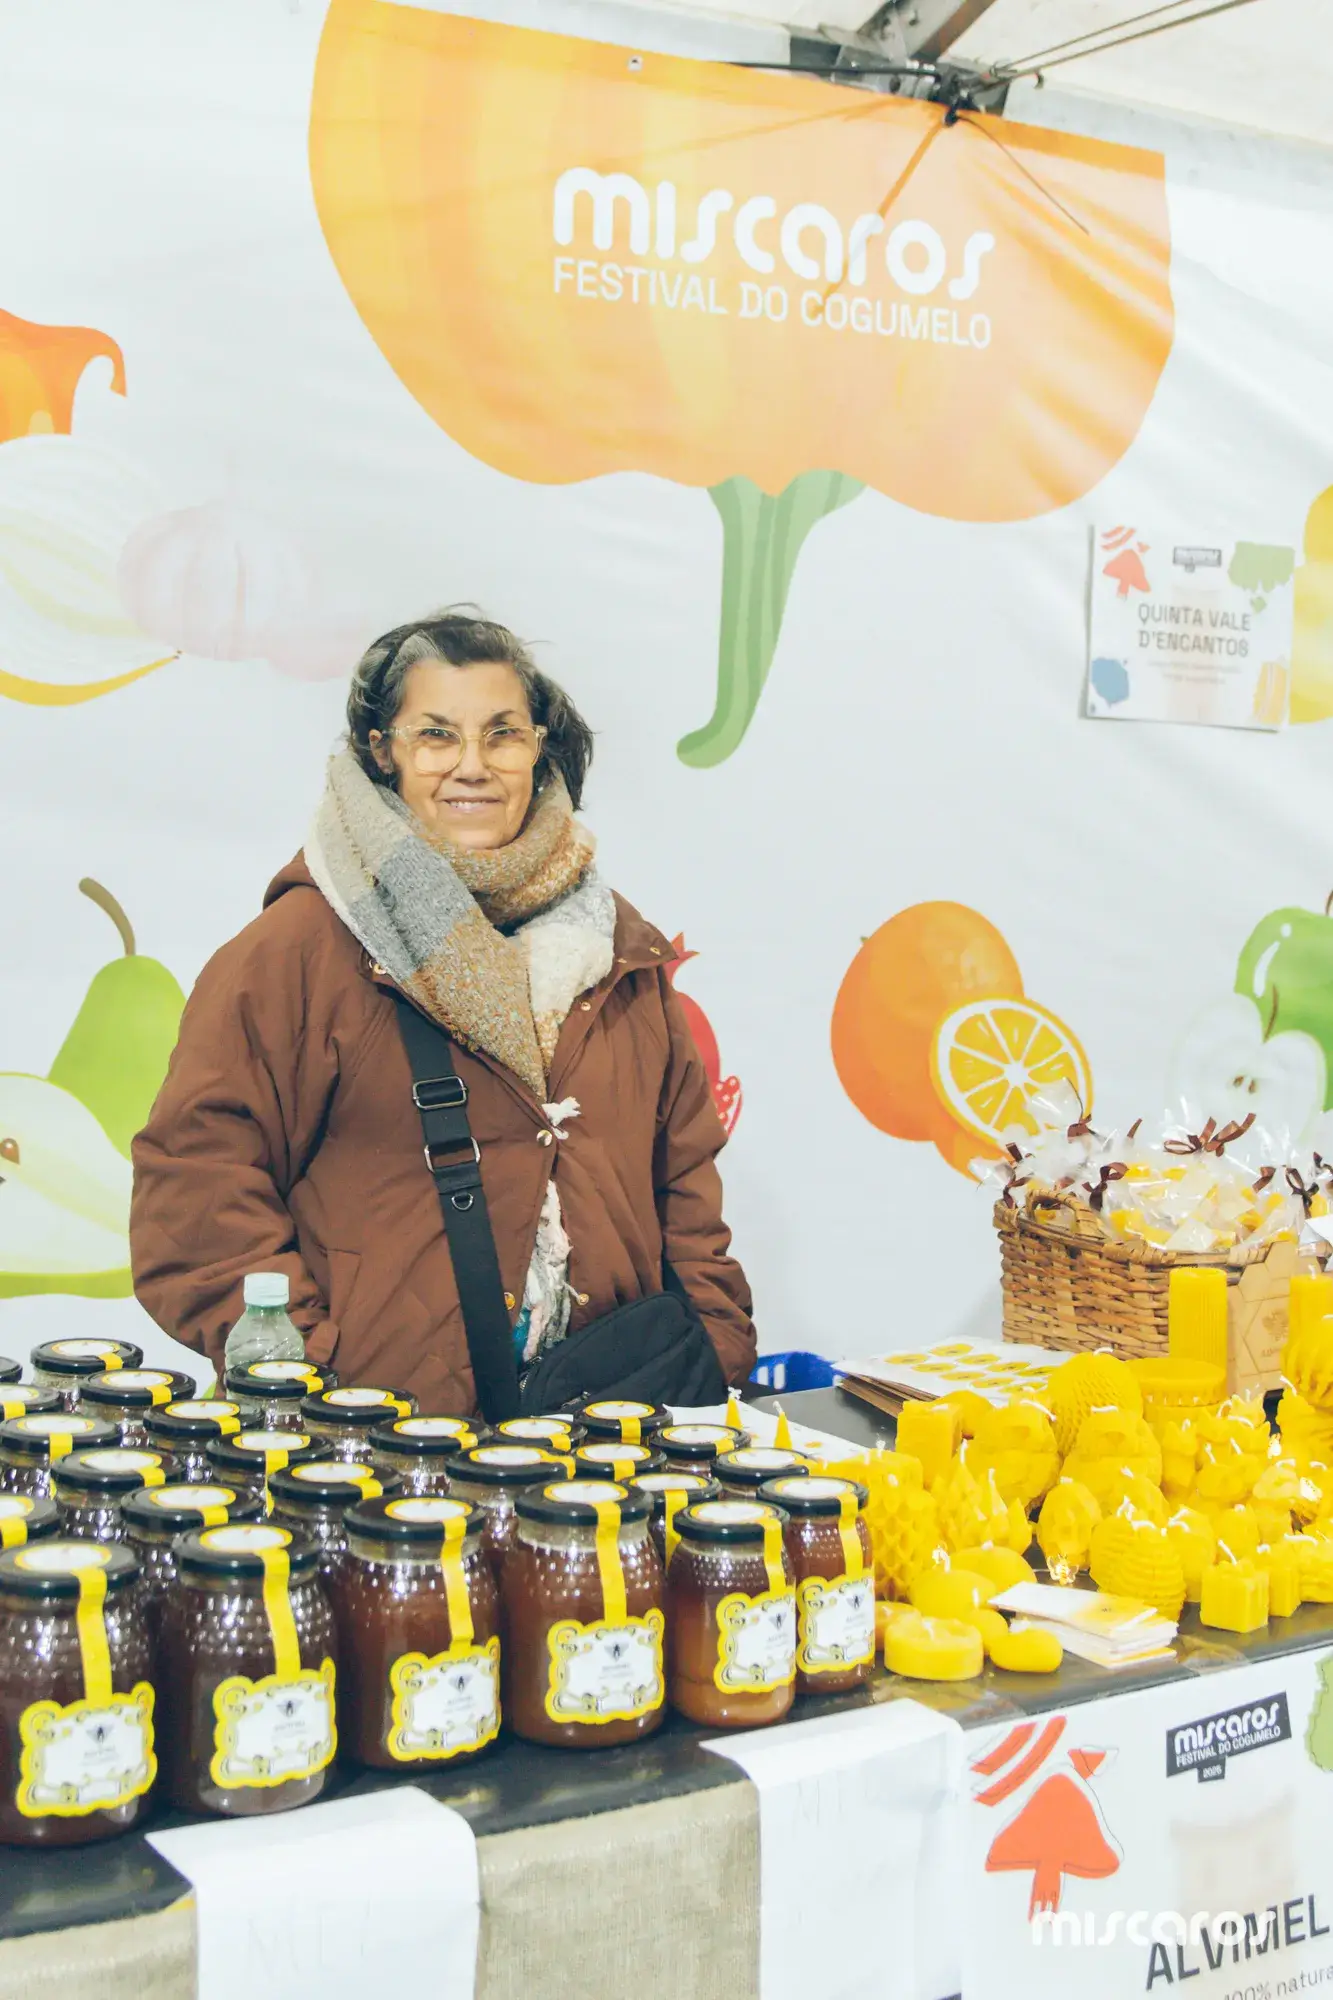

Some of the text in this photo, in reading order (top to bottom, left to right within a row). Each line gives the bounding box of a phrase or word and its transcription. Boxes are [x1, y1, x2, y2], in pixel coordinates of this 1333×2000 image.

[553, 257, 991, 349] FESTIVAL DO COGUMELO
[1138, 602, 1252, 632] QUINTA VALE
[1138, 630, 1249, 658] D'ENCANTOS
[1176, 1725, 1281, 1768] FESTIVAL DO COGUMELO
[1146, 1894, 1330, 1991] ALVIMEL
